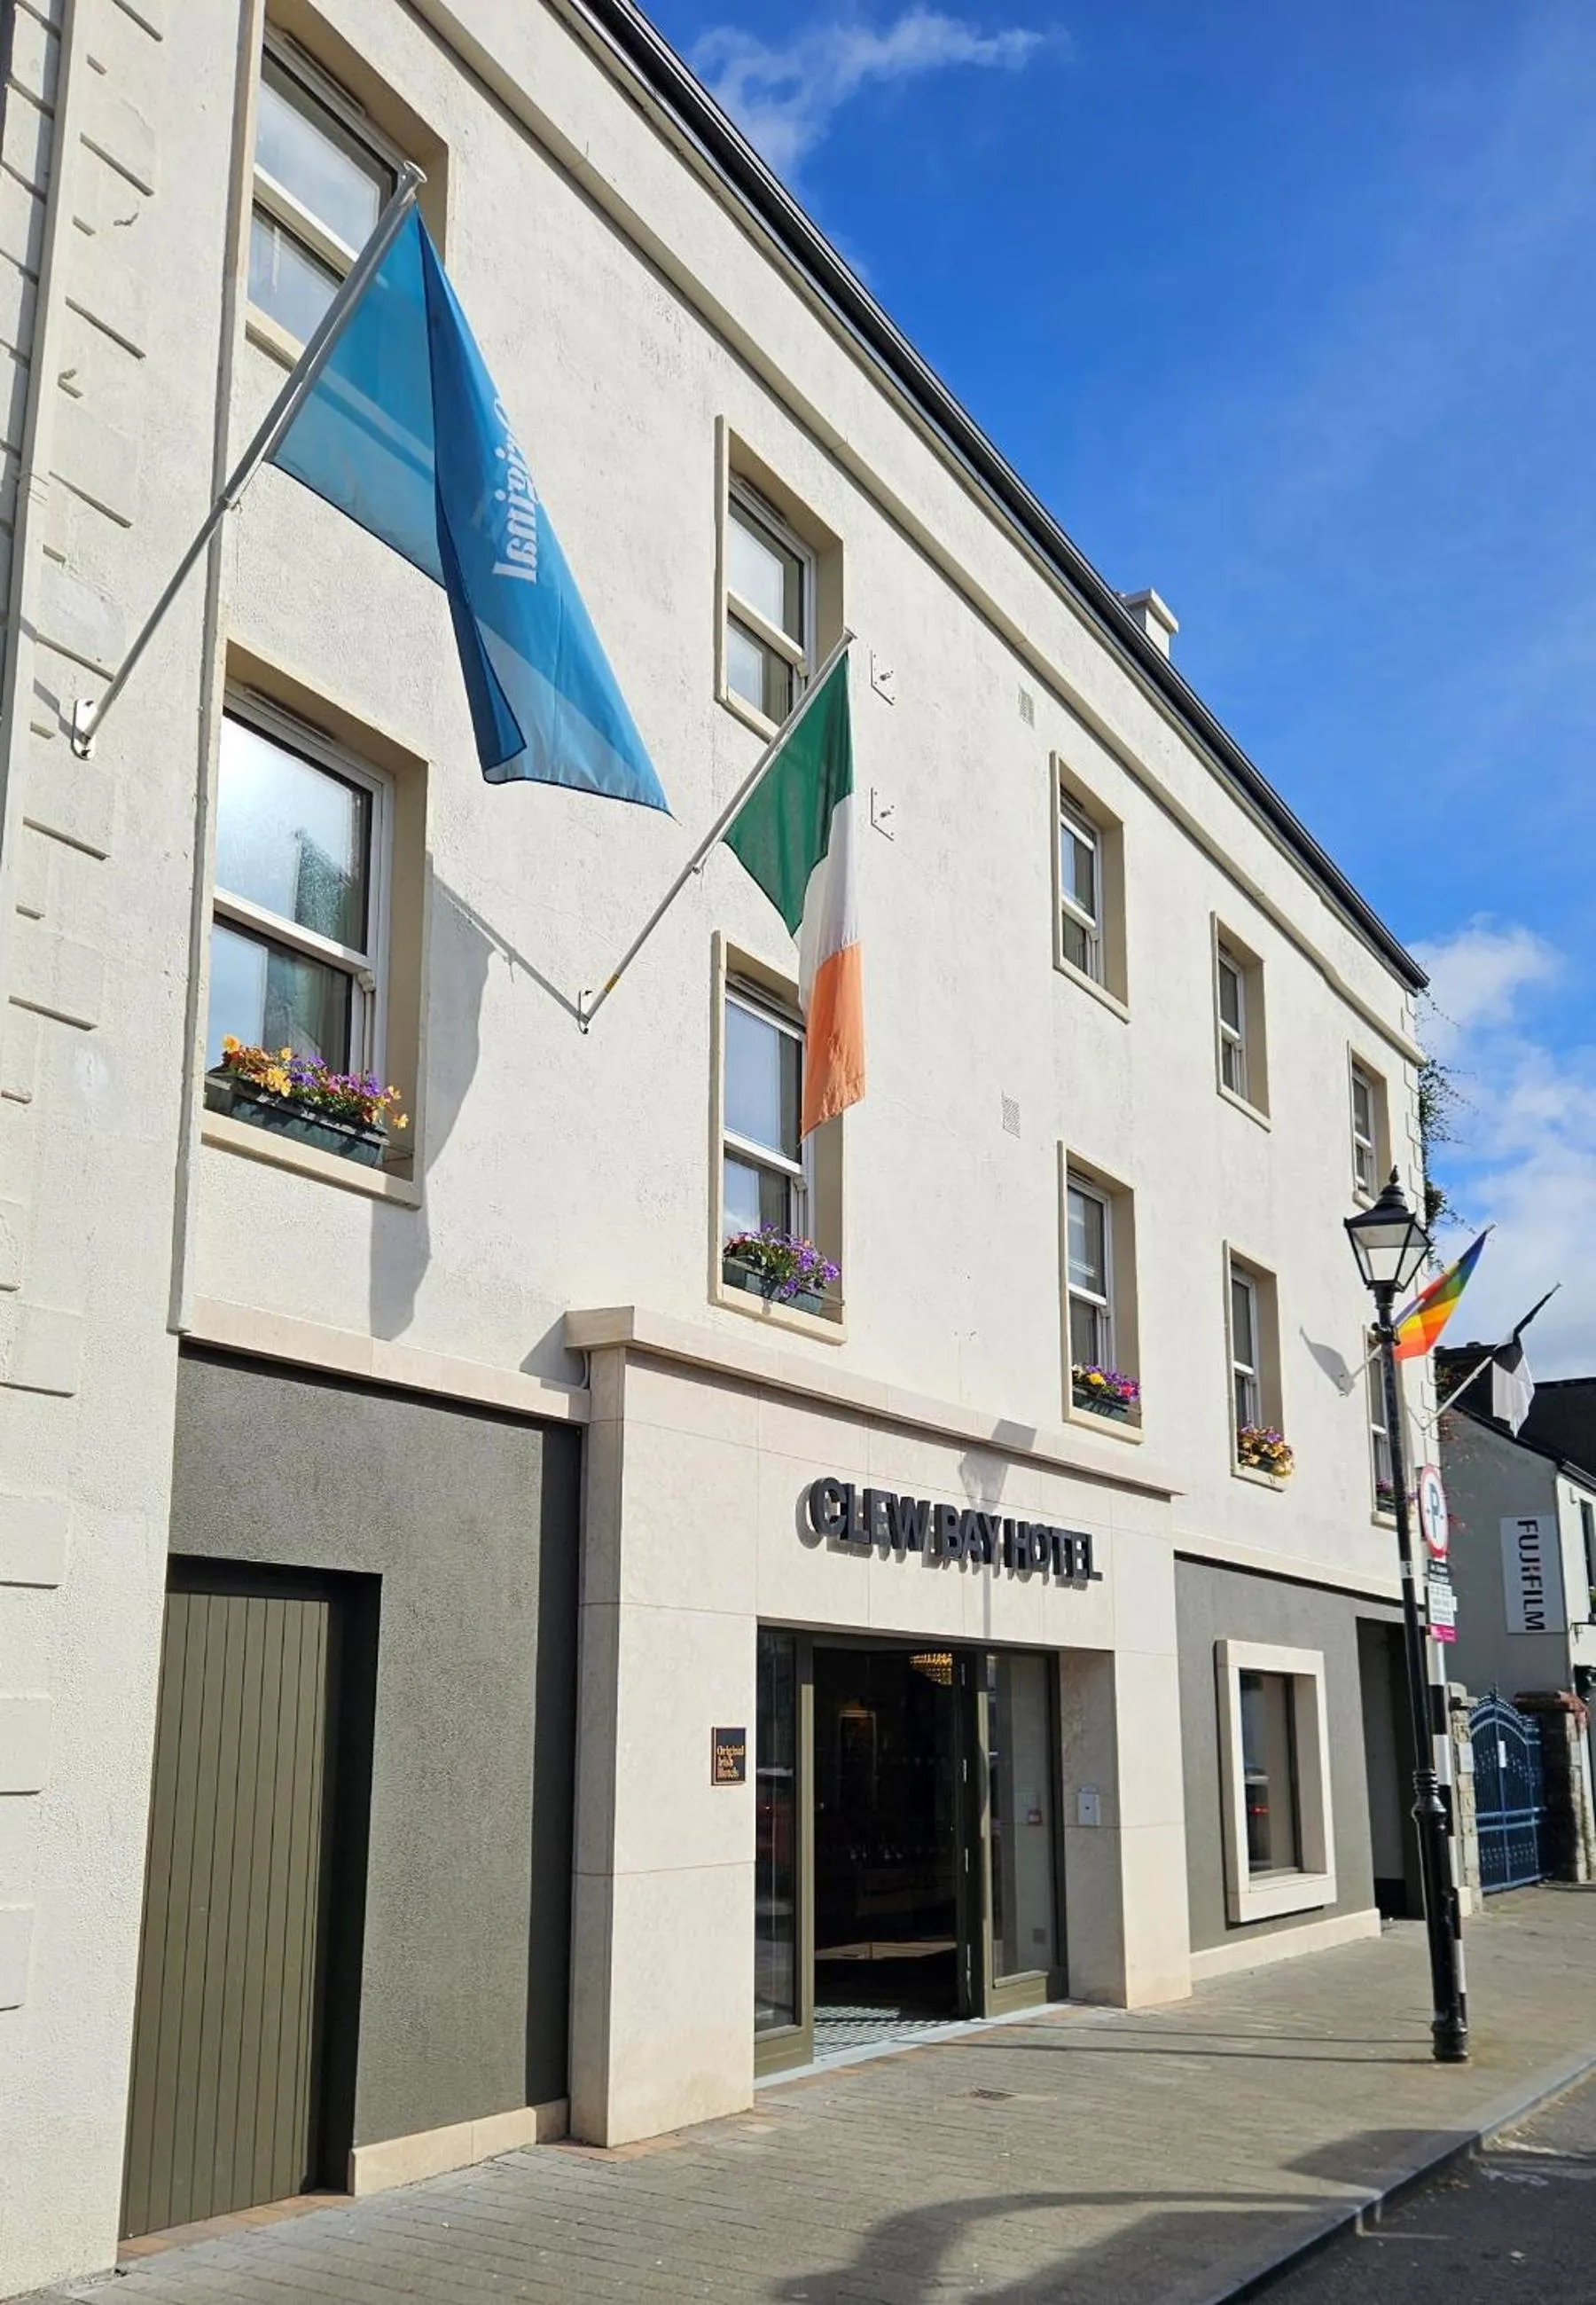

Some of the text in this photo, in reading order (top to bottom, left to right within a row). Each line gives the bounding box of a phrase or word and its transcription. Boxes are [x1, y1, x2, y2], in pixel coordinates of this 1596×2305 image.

[809, 1476, 1103, 1582] CLEW BAY HOTEL
[1516, 1518, 1546, 1631] FUJIFILM
[716, 1744, 745, 1758] Original
